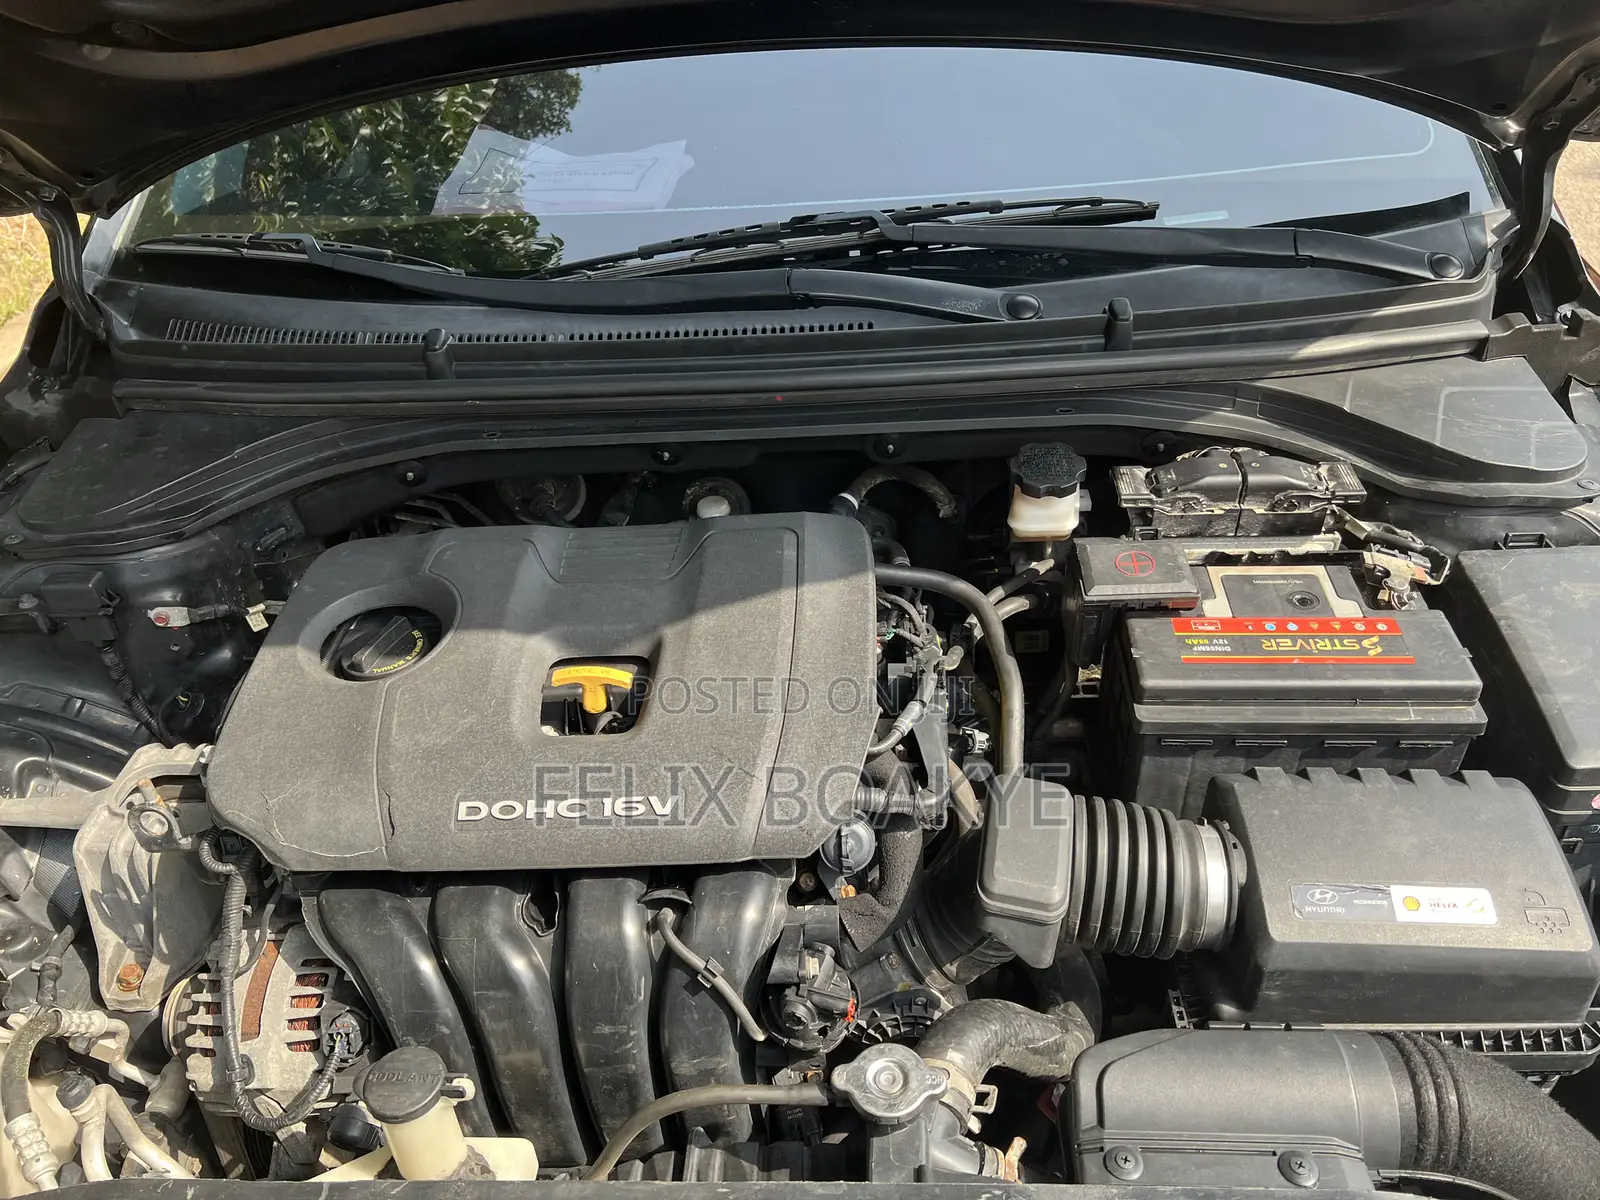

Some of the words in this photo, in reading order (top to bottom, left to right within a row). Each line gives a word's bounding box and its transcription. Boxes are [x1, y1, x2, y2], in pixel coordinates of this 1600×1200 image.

[412, 629, 423, 638] SEE
[372, 660, 405, 674] MANUAL
[457, 798, 589, 822] DOHC
[602, 796, 673, 818] 16V
[1304, 905, 1346, 915] HYUNDAI
[368, 1071, 441, 1084] COOLANT
